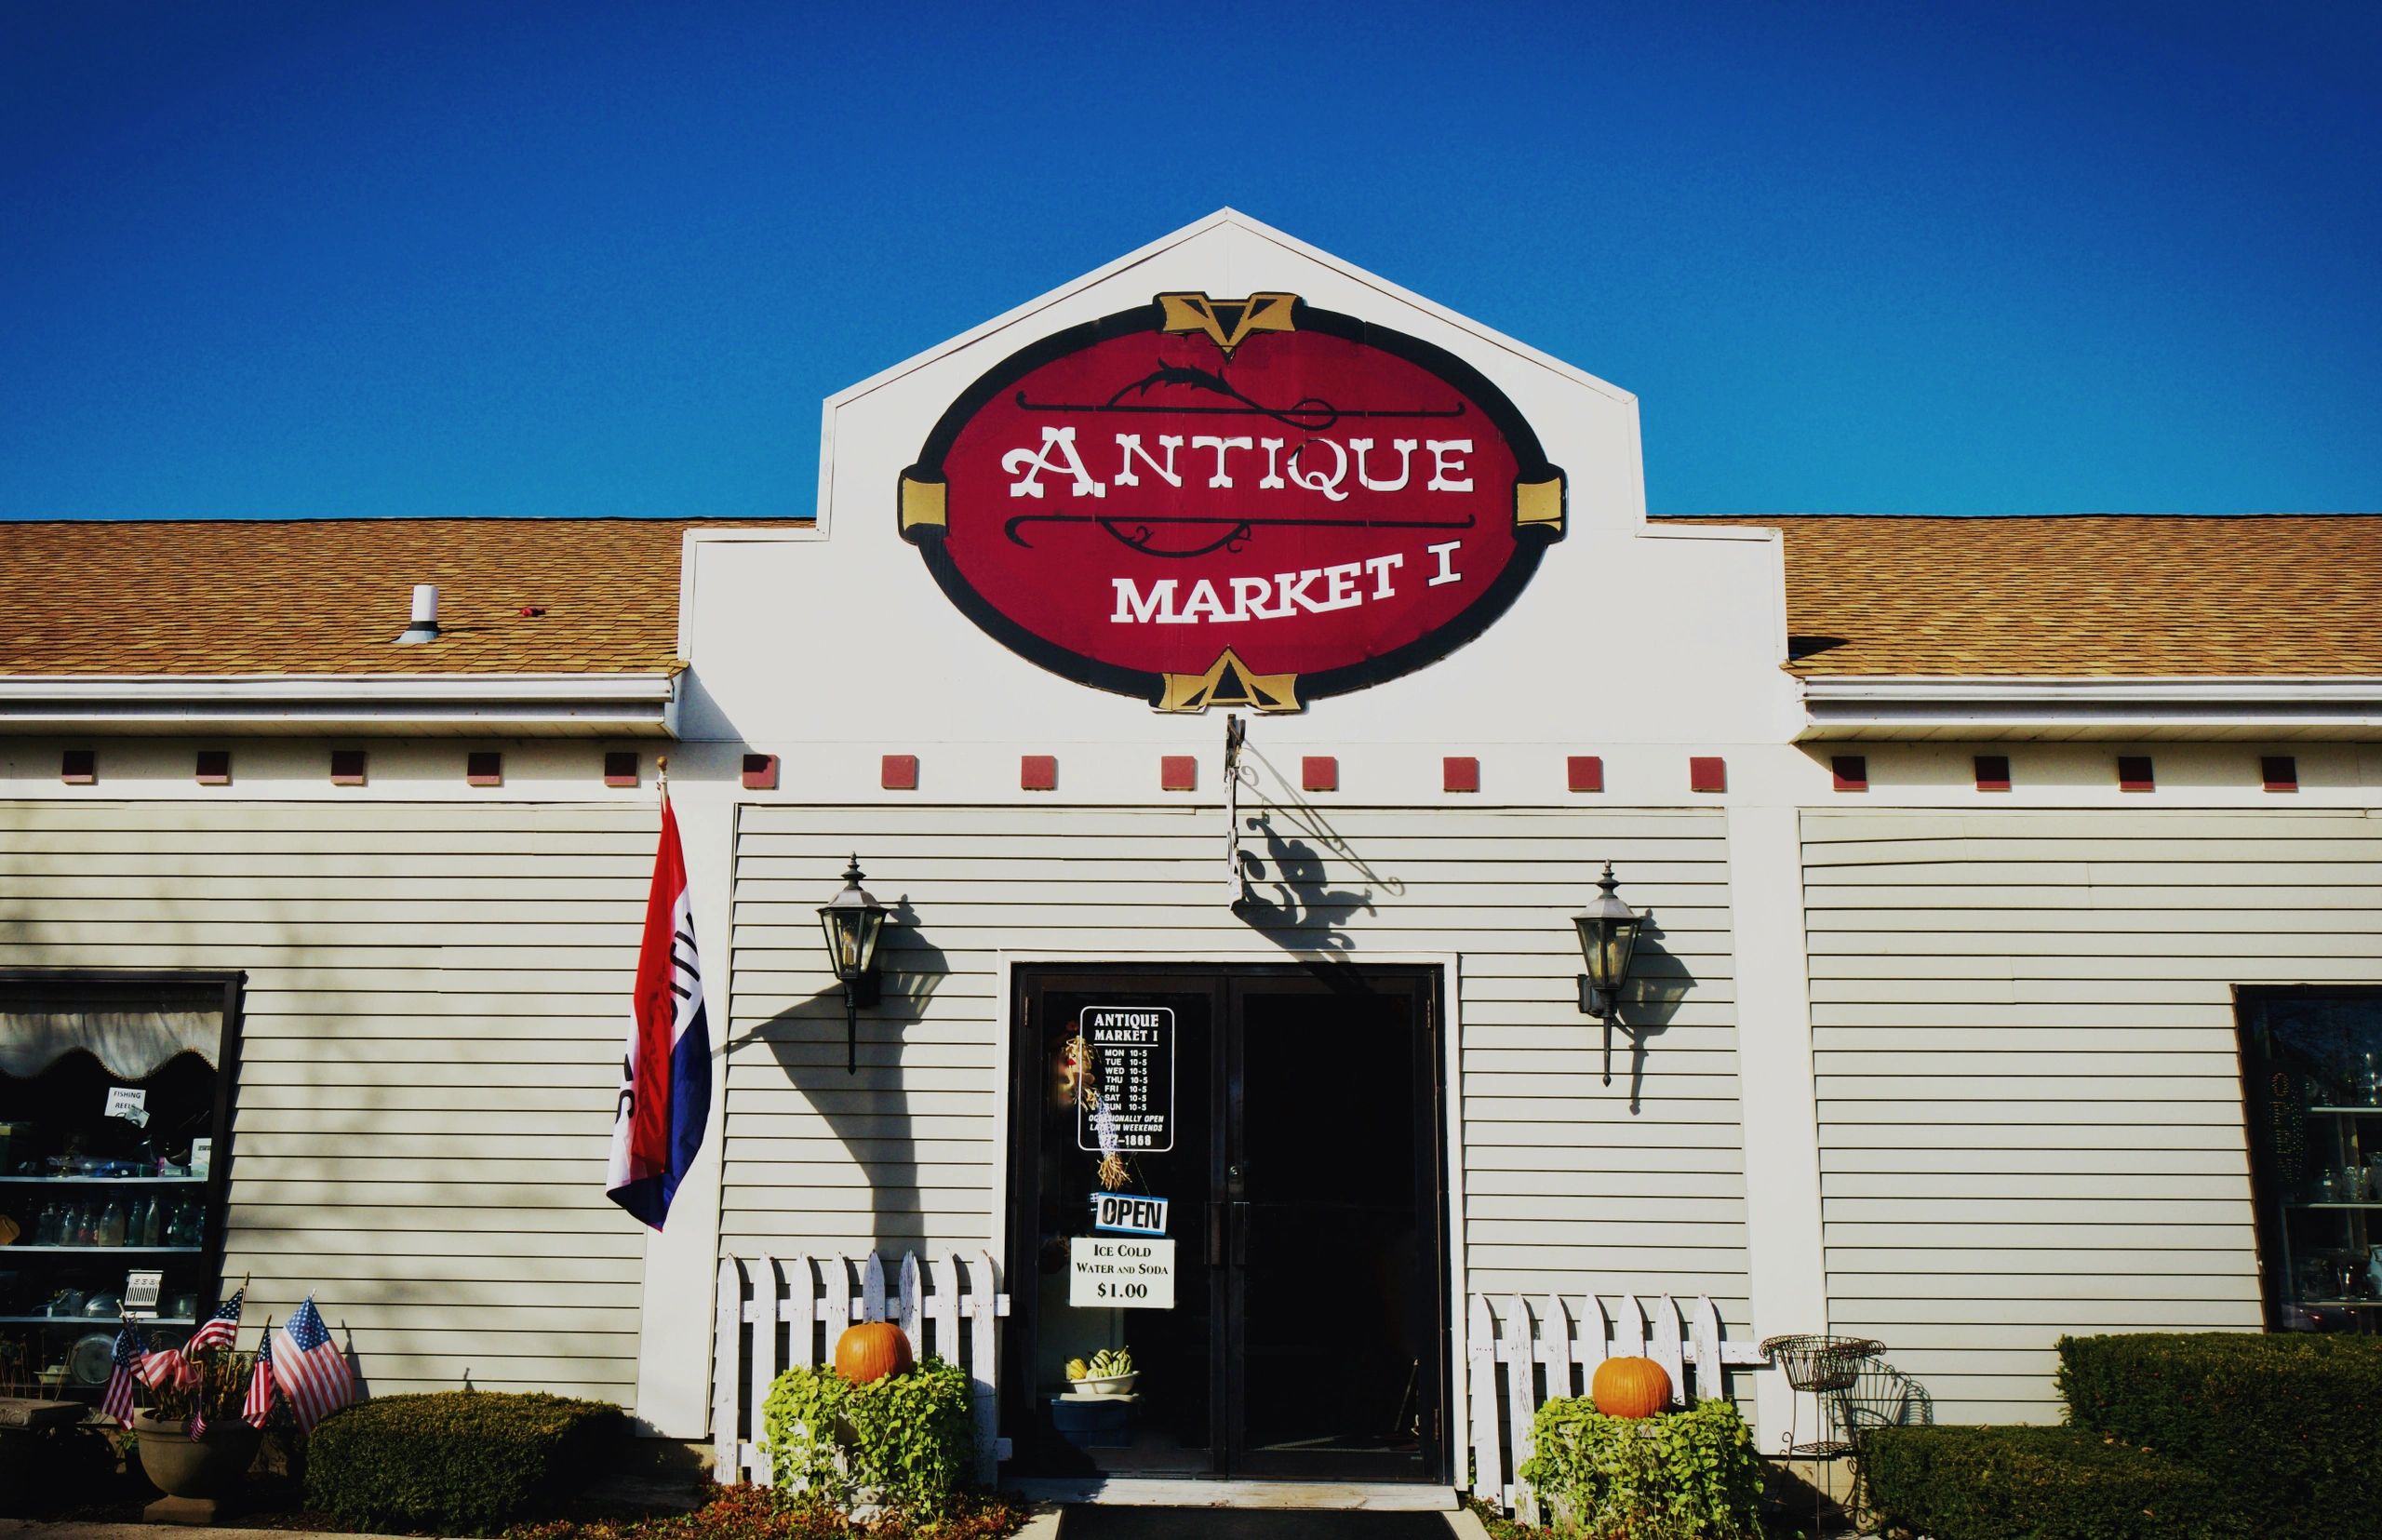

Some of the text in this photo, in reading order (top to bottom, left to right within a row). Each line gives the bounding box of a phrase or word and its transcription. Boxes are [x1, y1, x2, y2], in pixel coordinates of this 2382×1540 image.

[1001, 426, 1475, 502] ANTIQUE
[1110, 540, 1463, 623] MARKET I
[1094, 1013, 1159, 1029] ANTIQUE
[1094, 1029, 1158, 1042] MARKET I
[1104, 1050, 1124, 1058] MON
[1105, 1058, 1122, 1066] TUE
[1105, 1067, 1125, 1076] WED
[1105, 1076, 1123, 1084] THU
[1104, 1085, 1118, 1093] FRI
[114, 1091, 141, 1099] FISHING
[1104, 1093, 1120, 1102] SAT
[1104, 1103, 1122, 1111] SUN
[1089, 1114, 1164, 1123] OCIONALLY OPEN
[1123, 1124, 1163, 1132] WEEKENDS
[1102, 1198, 1162, 1229] OPEN
[1097, 1282, 1148, 1298] $1.00
